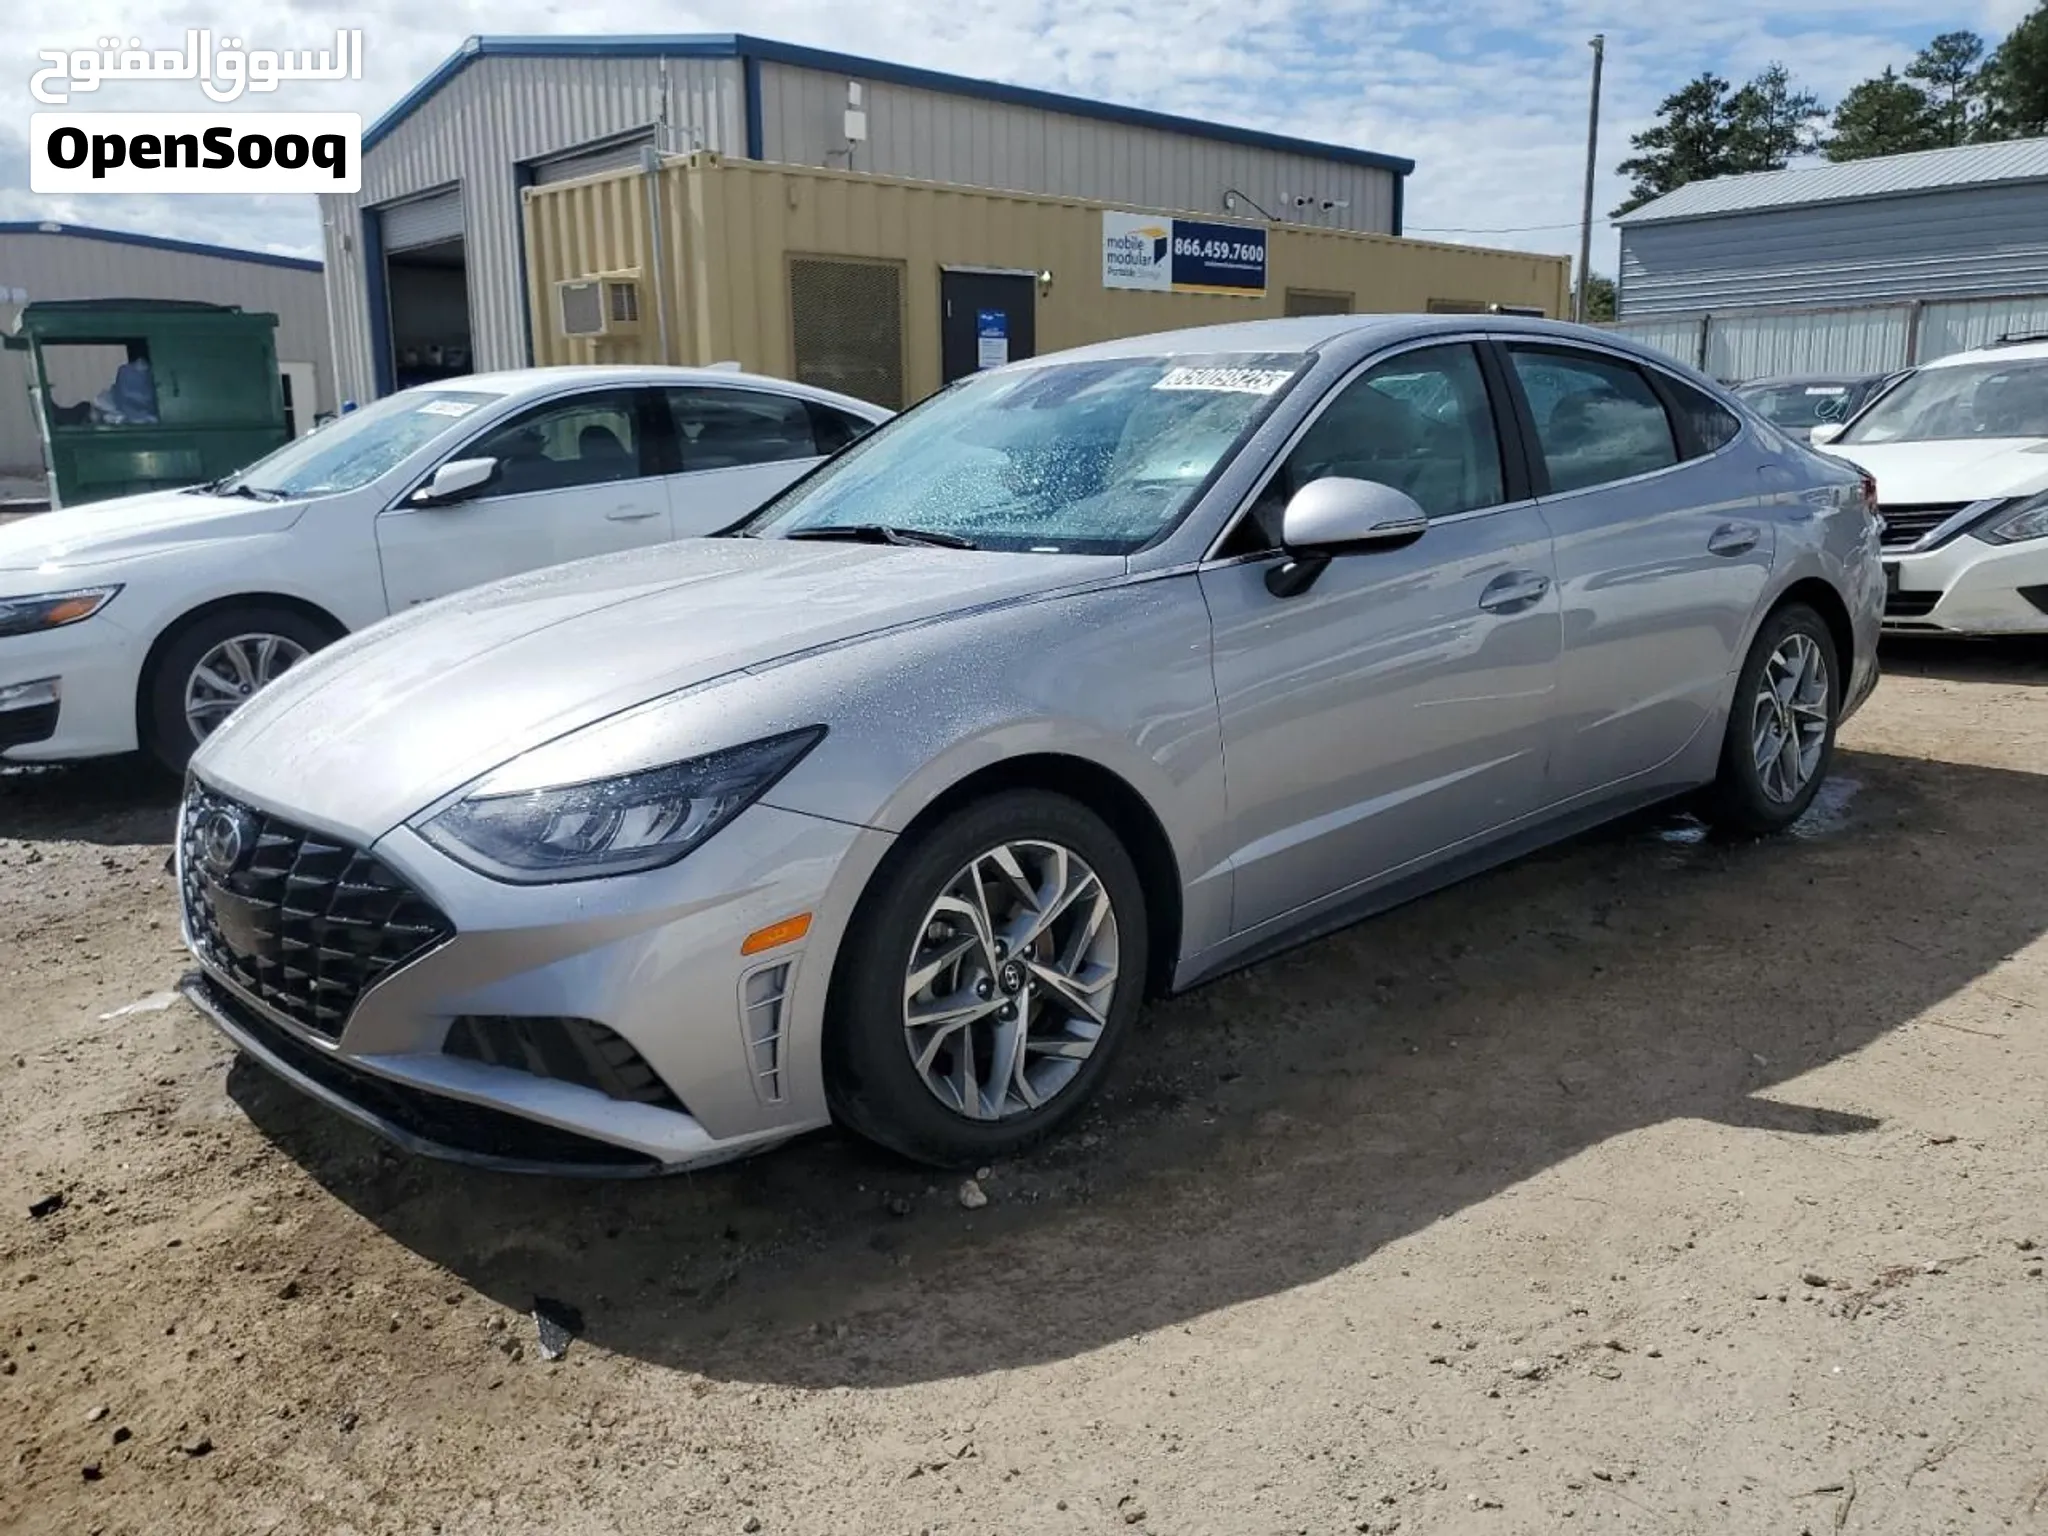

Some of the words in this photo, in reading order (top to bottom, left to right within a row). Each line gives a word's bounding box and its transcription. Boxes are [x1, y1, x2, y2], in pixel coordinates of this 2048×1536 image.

[1107, 235, 1144, 250] mobile
[1174, 237, 1264, 262] 866.459.7600
[1107, 251, 1151, 267] modular
